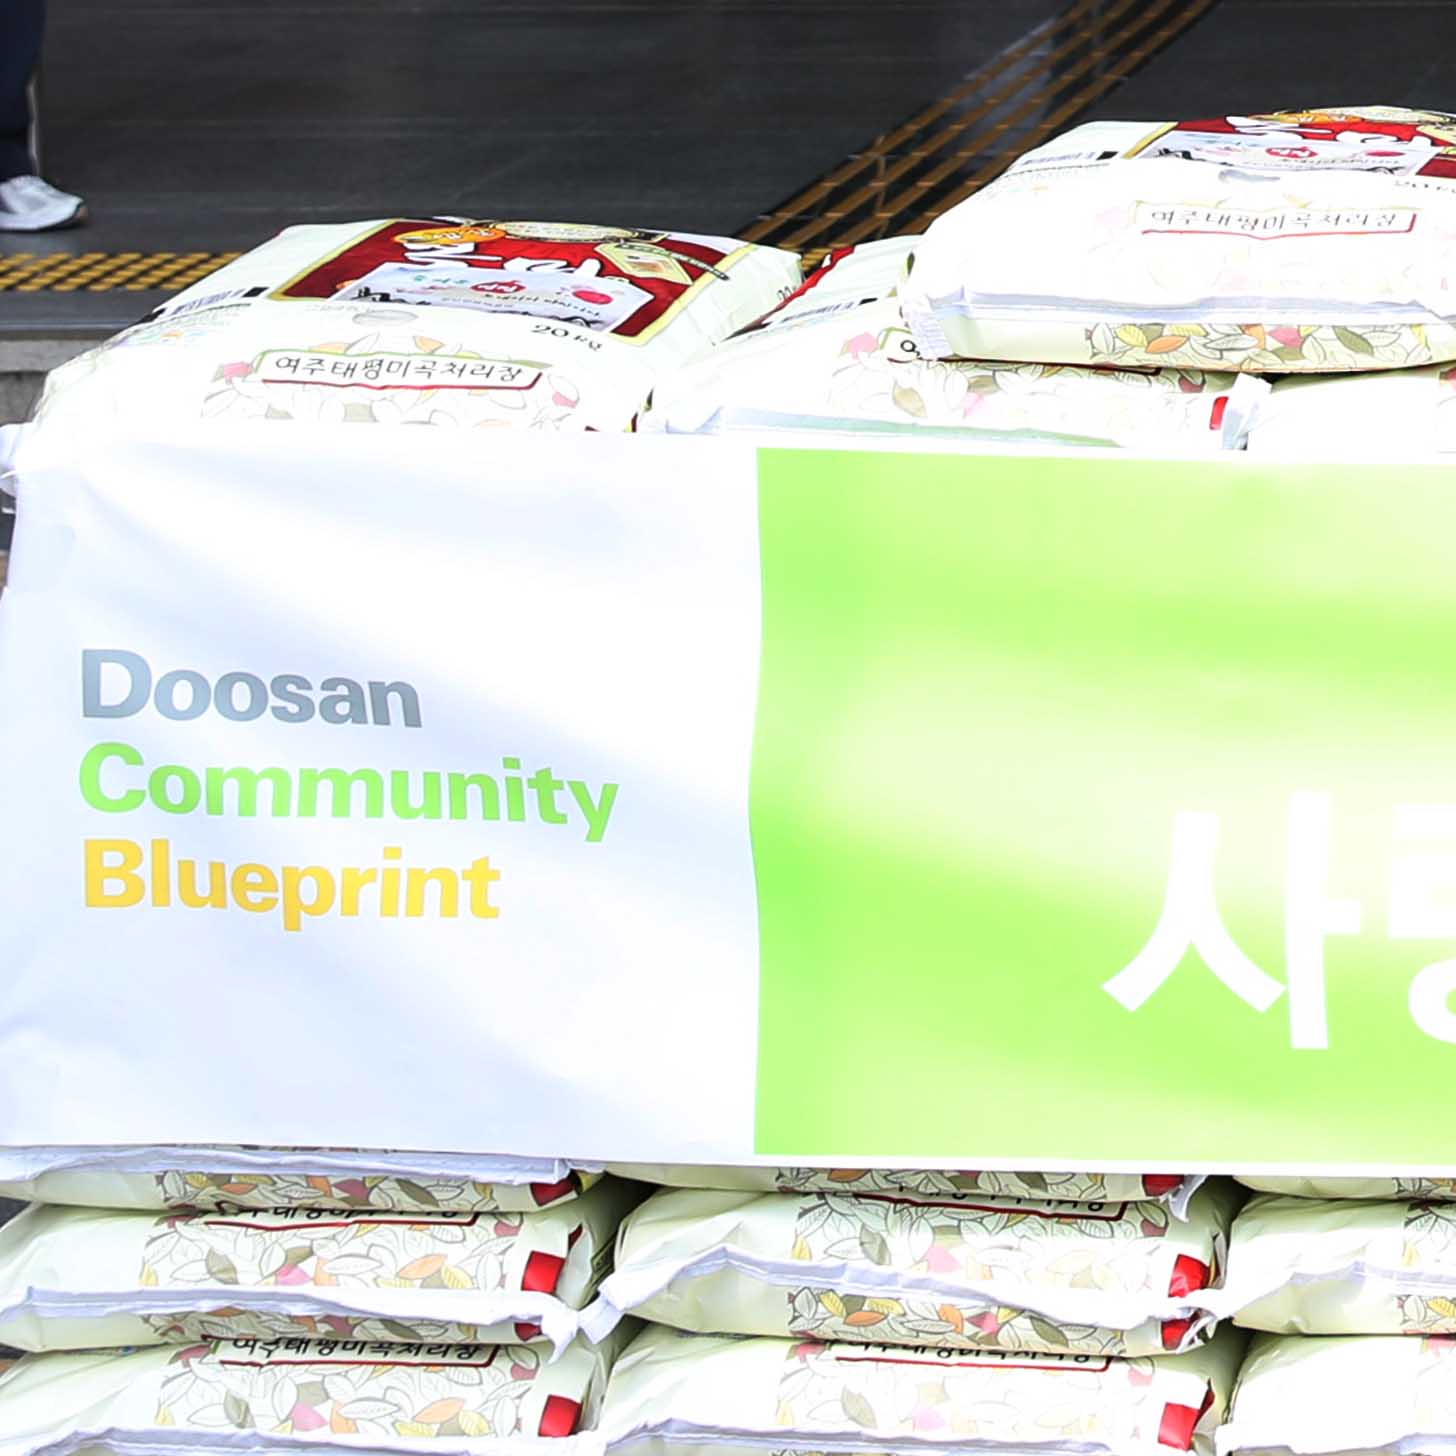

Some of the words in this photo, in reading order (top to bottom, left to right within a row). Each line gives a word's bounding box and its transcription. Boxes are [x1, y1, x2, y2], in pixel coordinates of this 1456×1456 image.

[275, 355, 524, 384] 여주태평미곡처리장
[81, 648, 423, 728] Doosan
[78, 741, 620, 843] Community
[83, 837, 503, 932] Blueprint
